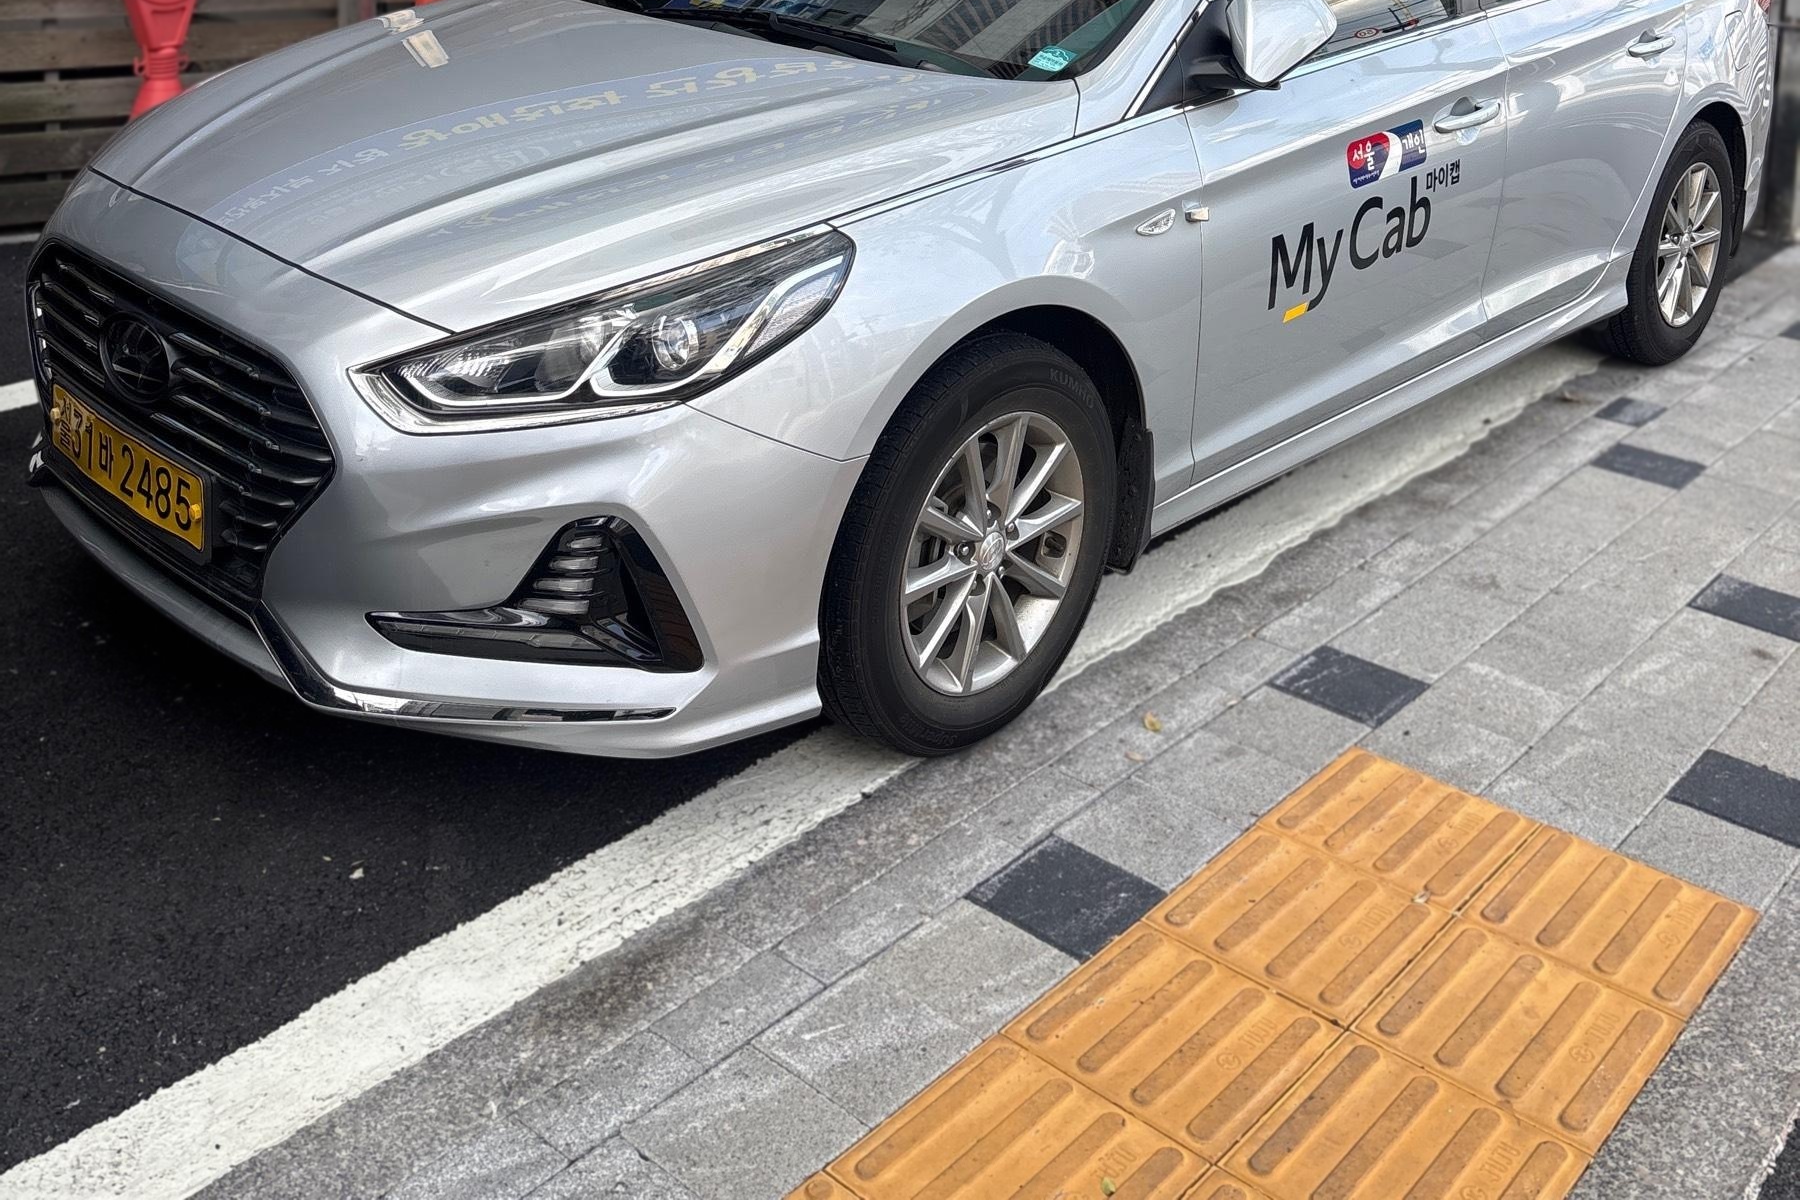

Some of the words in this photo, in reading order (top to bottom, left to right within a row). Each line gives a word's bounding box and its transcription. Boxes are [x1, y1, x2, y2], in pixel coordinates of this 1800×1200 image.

[1352, 142, 1376, 170] 서울
[1400, 129, 1426, 153] 개인
[1426, 158, 1462, 192] 마이캡
[1267, 221, 1344, 312] My
[1349, 176, 1432, 270] Cab
[119, 444, 193, 532] 2485
